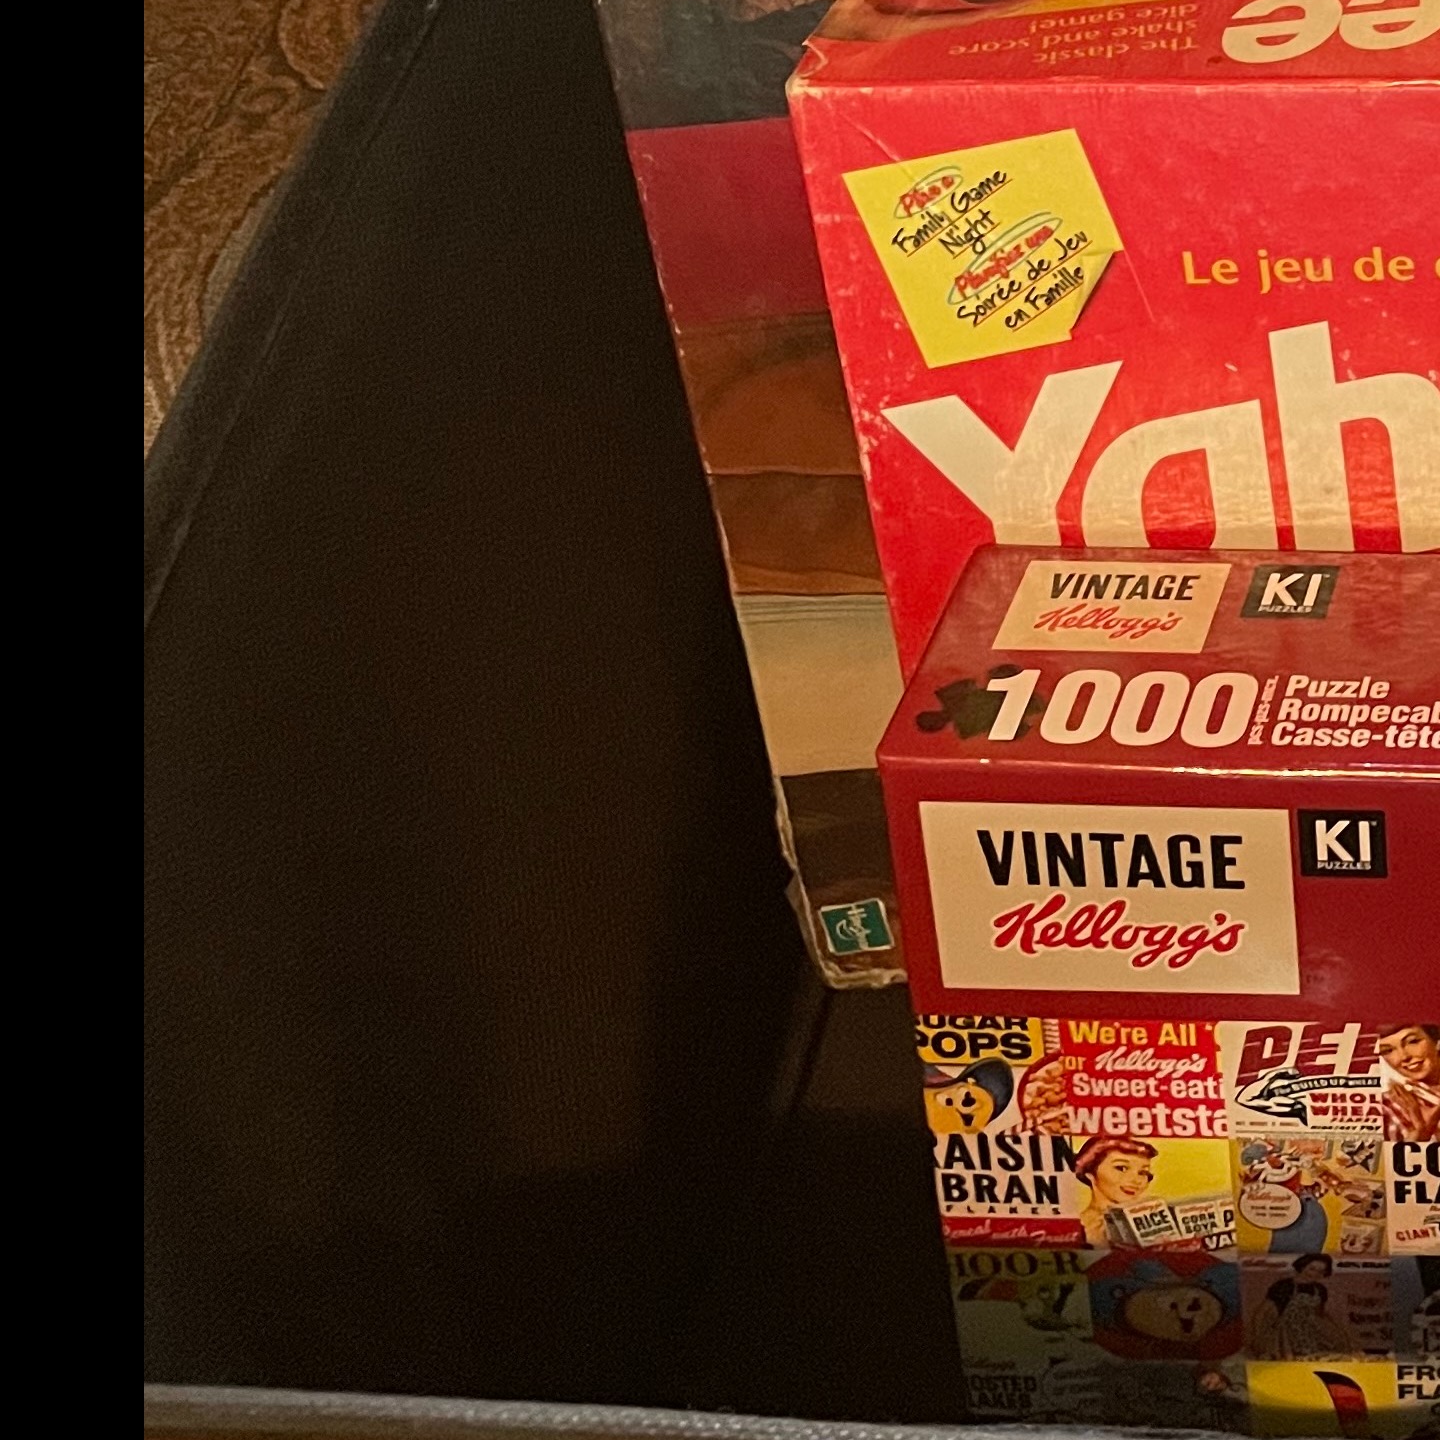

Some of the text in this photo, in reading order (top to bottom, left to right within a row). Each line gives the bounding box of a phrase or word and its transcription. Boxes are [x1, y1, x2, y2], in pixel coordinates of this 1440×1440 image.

[1183, 250, 1238, 285] Le
[1259, 248, 1335, 294] jeu
[1368, 245, 1417, 282] de
[1050, 574, 1201, 601] VINTAGE
[1260, 572, 1321, 607] KI
[1032, 604, 1184, 640] Kellogg's
[1284, 673, 1390, 701] Puzzle
[985, 667, 1259, 749] 1000
[1315, 818, 1373, 862] KI
[976, 828, 1246, 890] VINTAGE
[1316, 860, 1373, 872] PUZZLES
[991, 892, 1247, 970] Kellogg's
[1069, 1023, 1199, 1049] We're All
[942, 1171, 1060, 1204] BRAN
